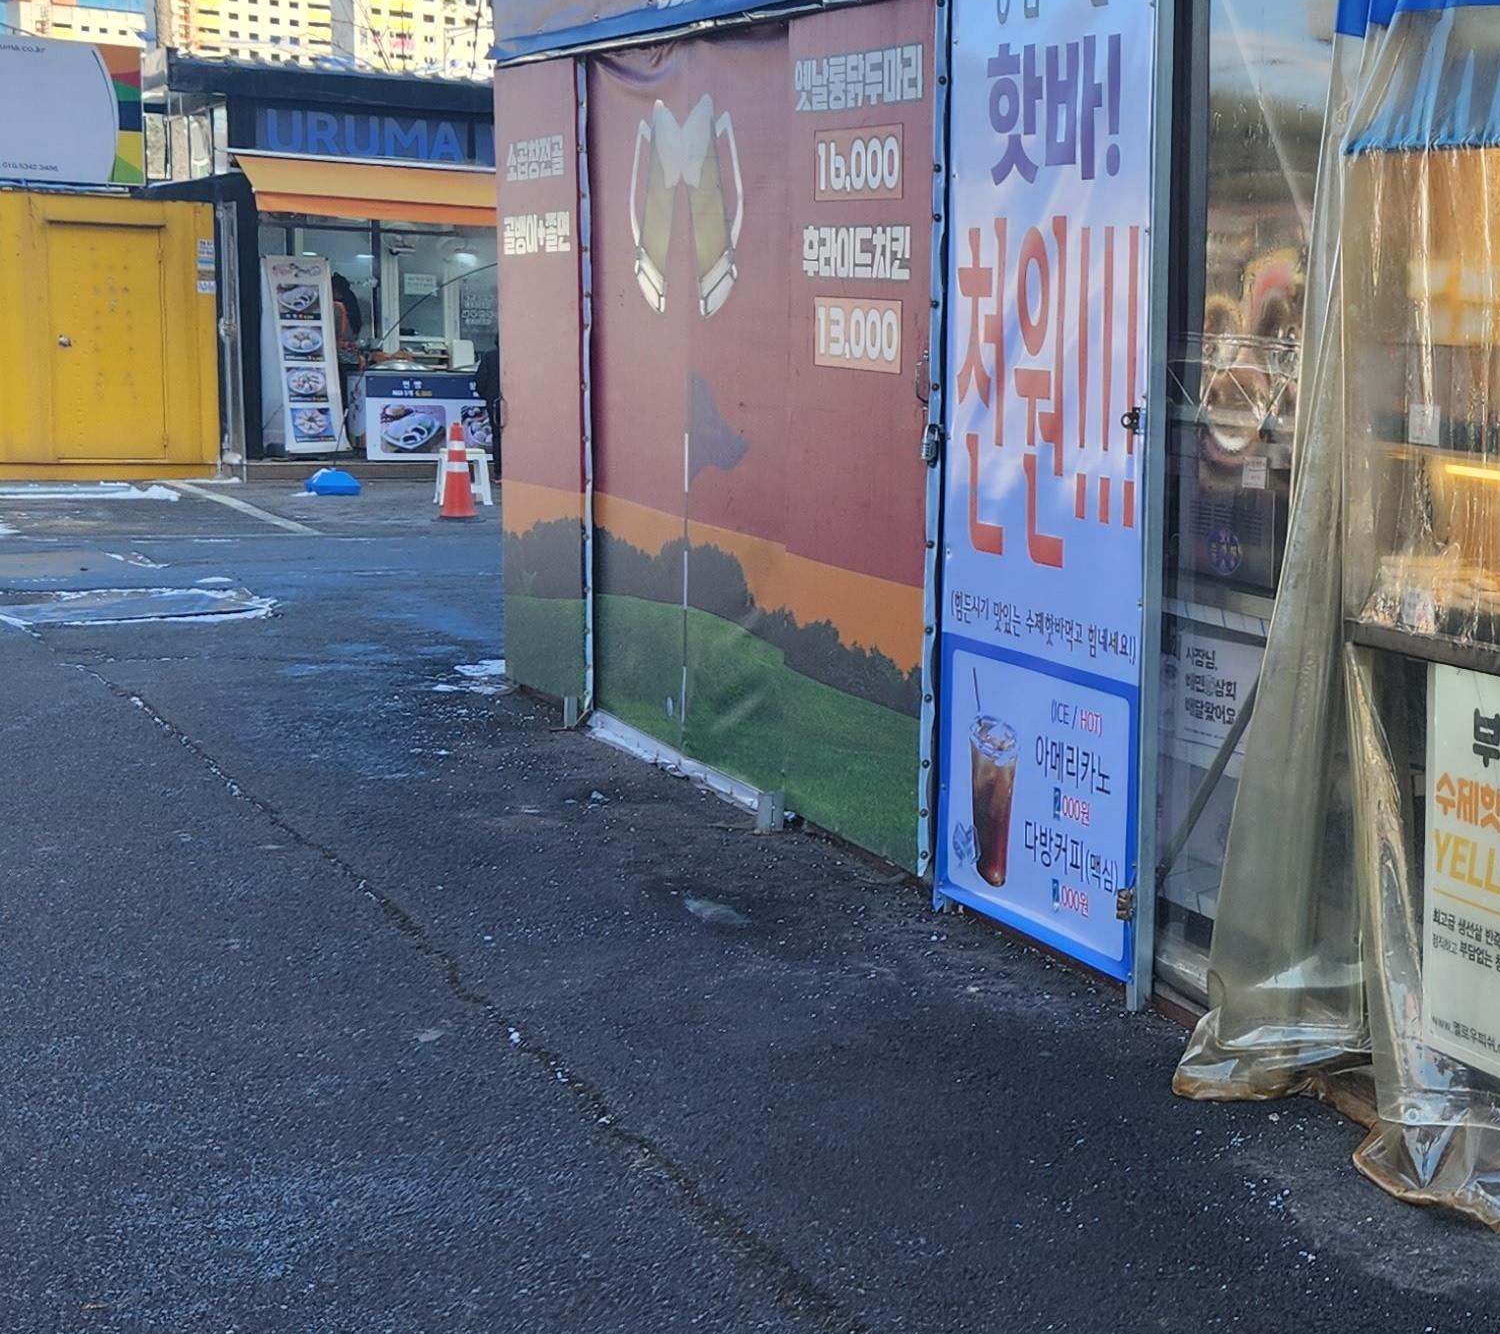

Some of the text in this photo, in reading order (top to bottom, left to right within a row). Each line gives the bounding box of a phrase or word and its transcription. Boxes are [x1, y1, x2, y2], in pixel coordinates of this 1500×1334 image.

[266, 108, 466, 163] URUMA
[987, 33, 1121, 186] 핫바!
[817, 136, 900, 193] 16,000
[802, 225, 912, 280] 후라이드치킨
[817, 305, 900, 363] 13,000
[993, 602, 1020, 637] 맛있는
[1035, 735, 1111, 795] 아메리카노
[1433, 908, 1457, 931] 최고급
[1458, 917, 1483, 943] 생선살
[1459, 941, 1493, 968] 부담없는
